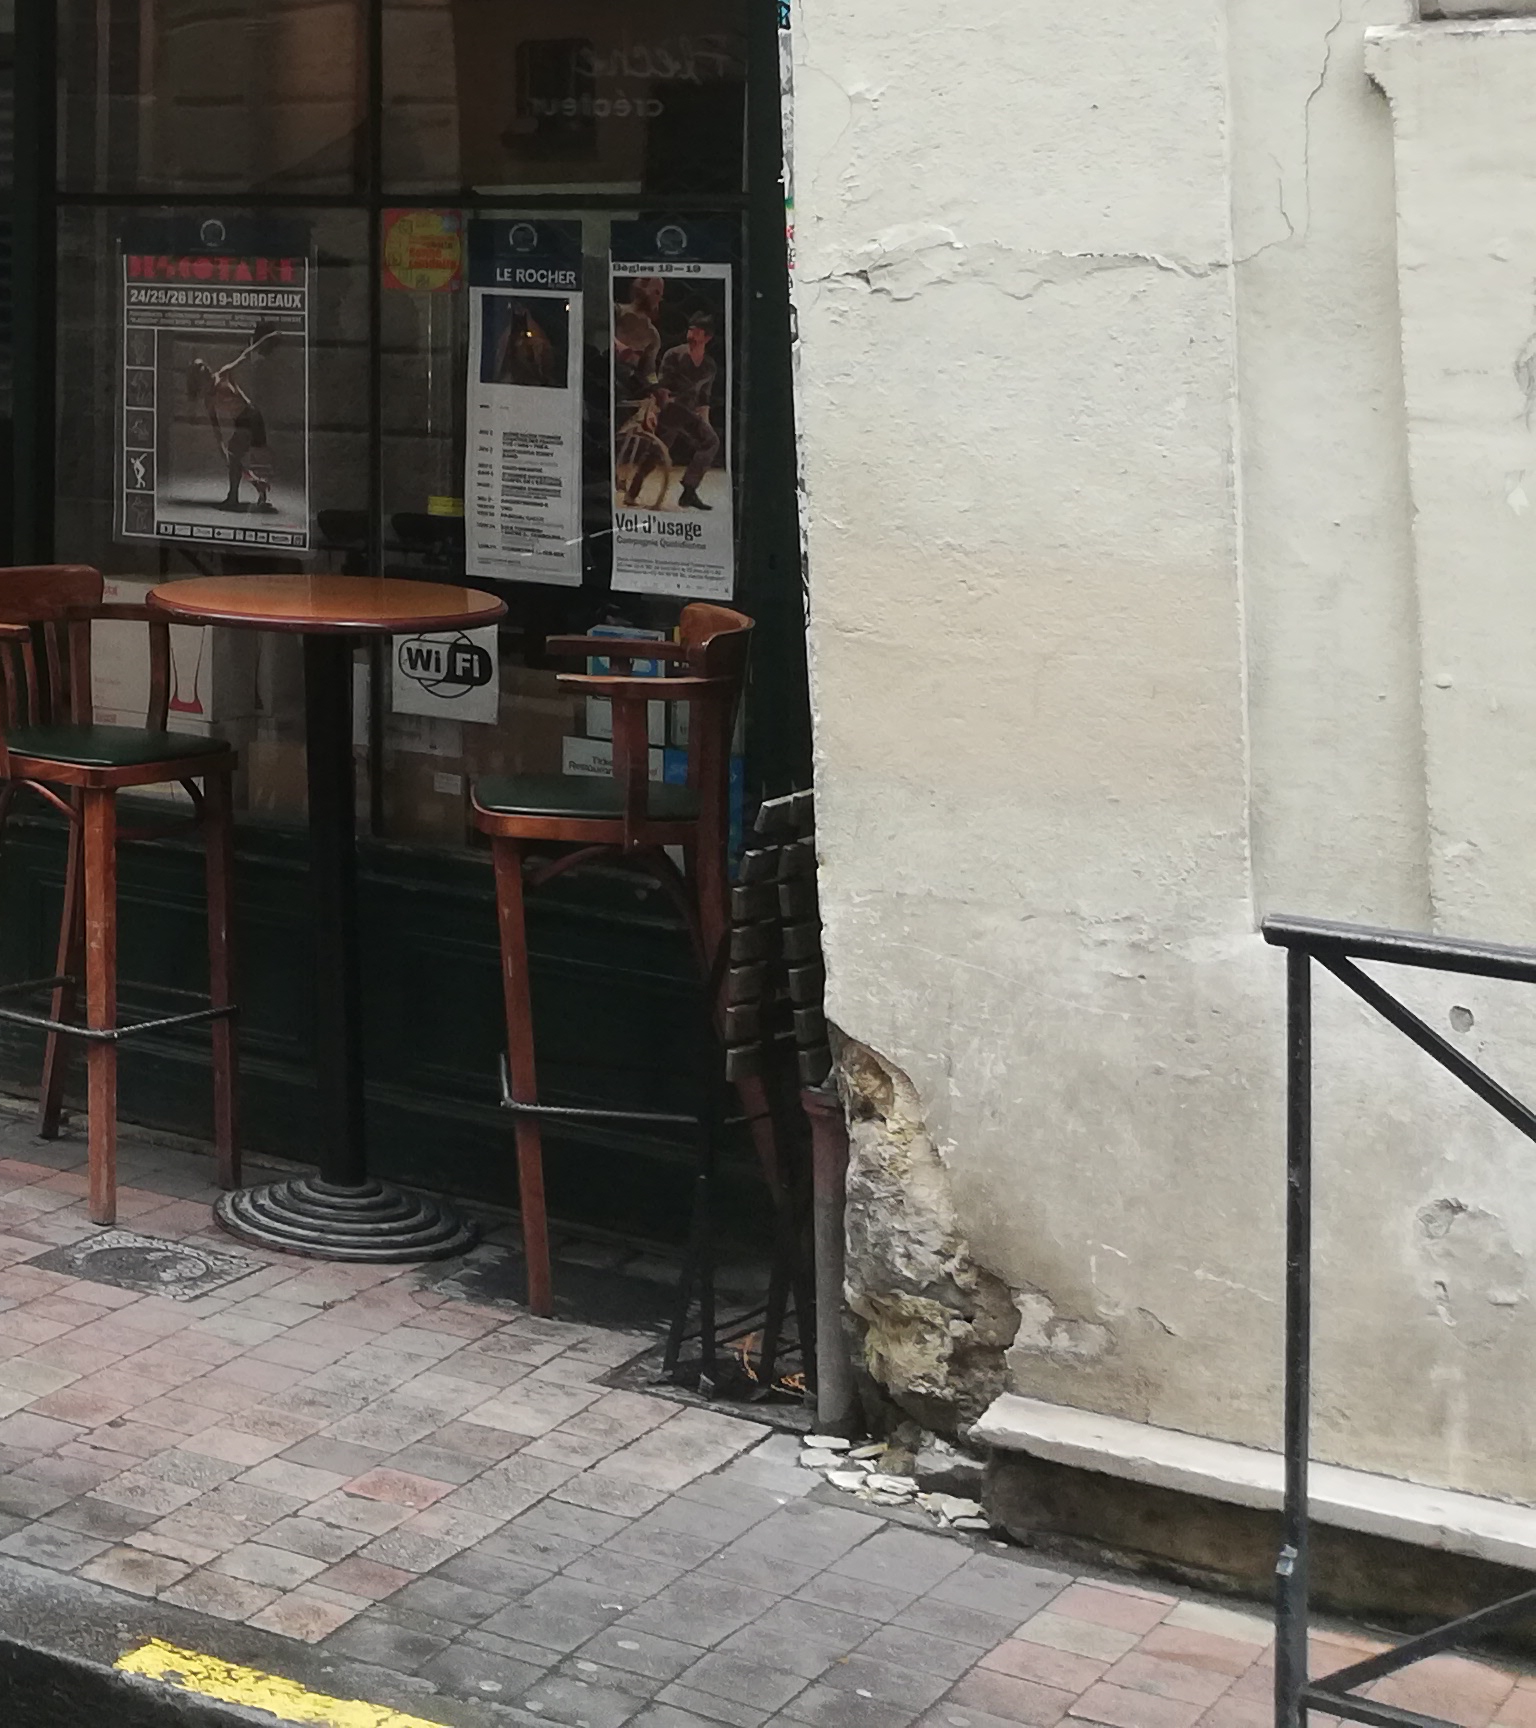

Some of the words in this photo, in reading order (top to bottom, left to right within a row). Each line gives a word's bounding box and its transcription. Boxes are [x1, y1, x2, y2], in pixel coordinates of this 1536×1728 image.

[496, 267, 512, 282] LE
[516, 268, 576, 284] ROCHER
[615, 512, 638, 533] Vol
[642, 514, 702, 541] d'usage
